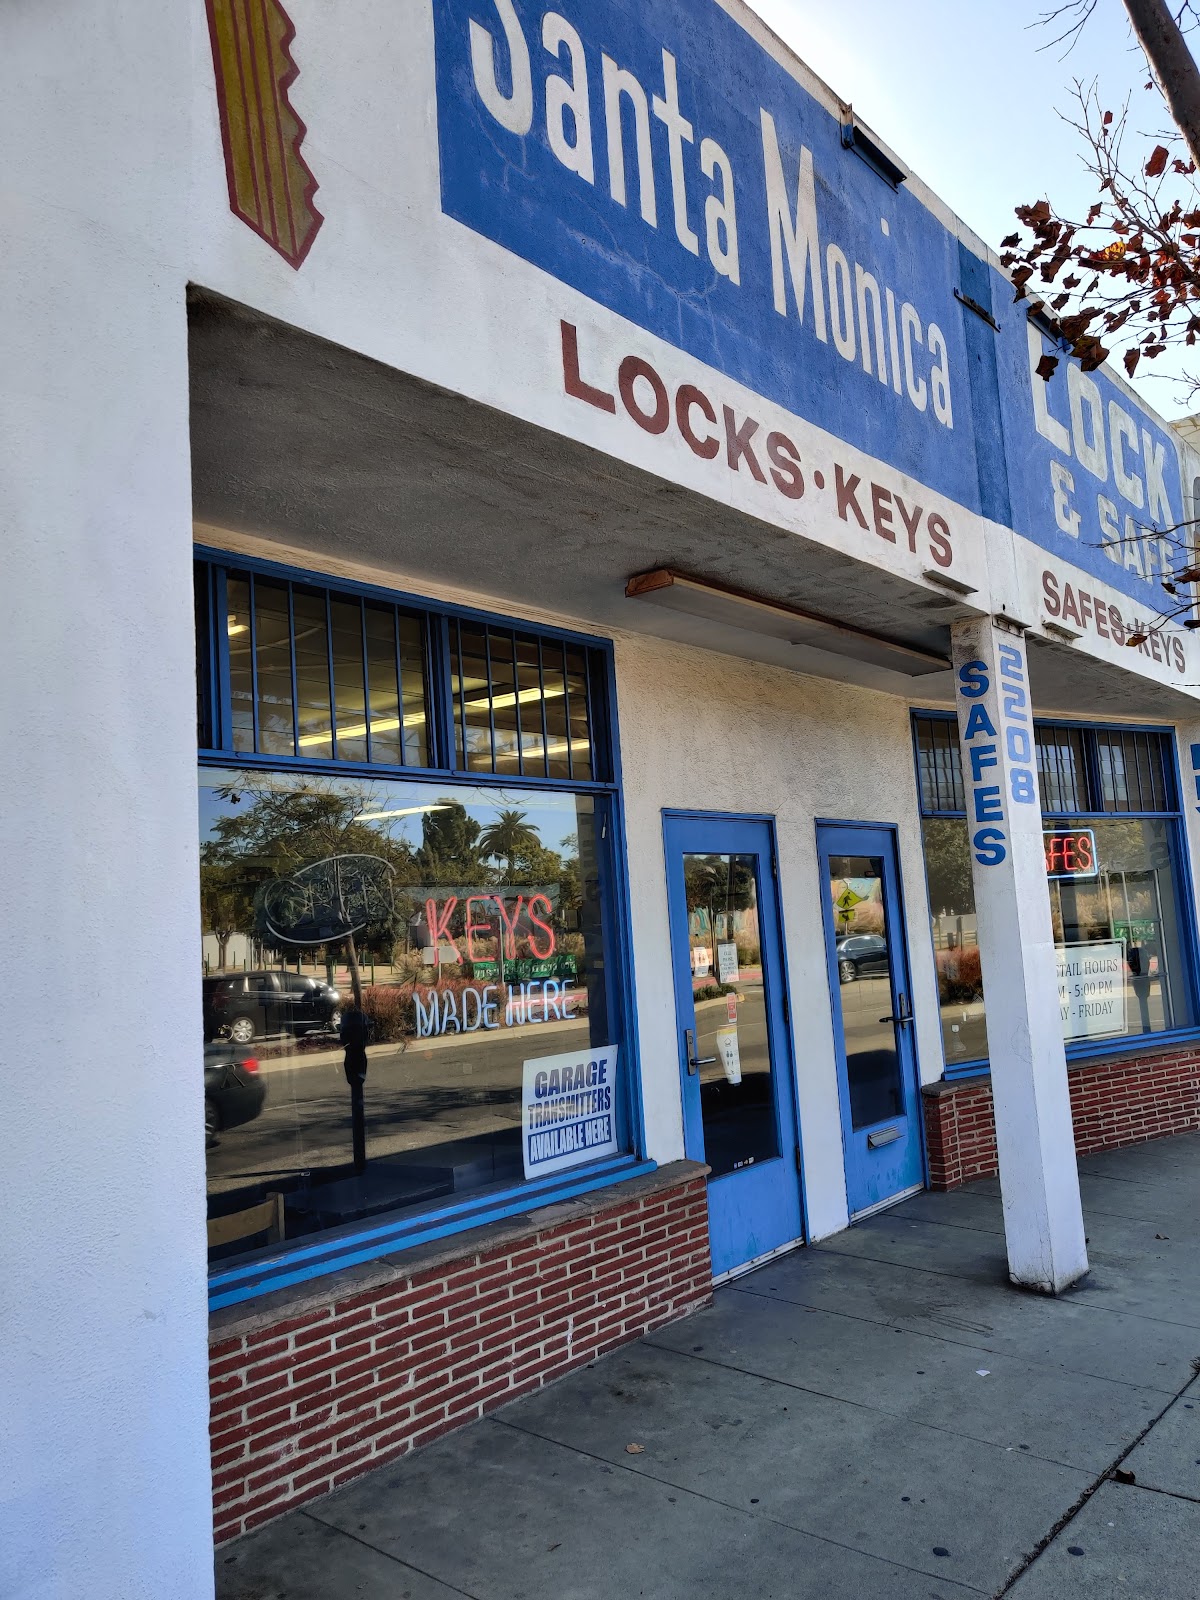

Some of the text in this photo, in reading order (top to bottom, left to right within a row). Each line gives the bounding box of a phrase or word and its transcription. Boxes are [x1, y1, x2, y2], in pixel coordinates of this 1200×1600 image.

[760, 107, 954, 429] Monica
[560, 319, 954, 568] LOCKS KEYS
[1027, 320, 1178, 537] LOCK
[1050, 460, 1179, 601] & SAFE
[1042, 570, 1126, 646] SAFES
[998, 644, 1036, 805] 2208
[959, 660, 1008, 866] SAFES
[1045, 836, 1092, 871] FES
[425, 893, 556, 967] KEYS
[1074, 983, 1096, 998] 5:00
[1098, 980, 1113, 994] PM
[1084, 959, 1118, 975] HOURS
[412, 979, 576, 1039] MADE HERE
[1078, 1001, 1114, 1018] FRIDAY
[527, 1086, 611, 1130] TRANSMITTERS
[534, 1059, 608, 1099] GARAGE
[530, 1117, 610, 1162] AVAILABLE HERE
